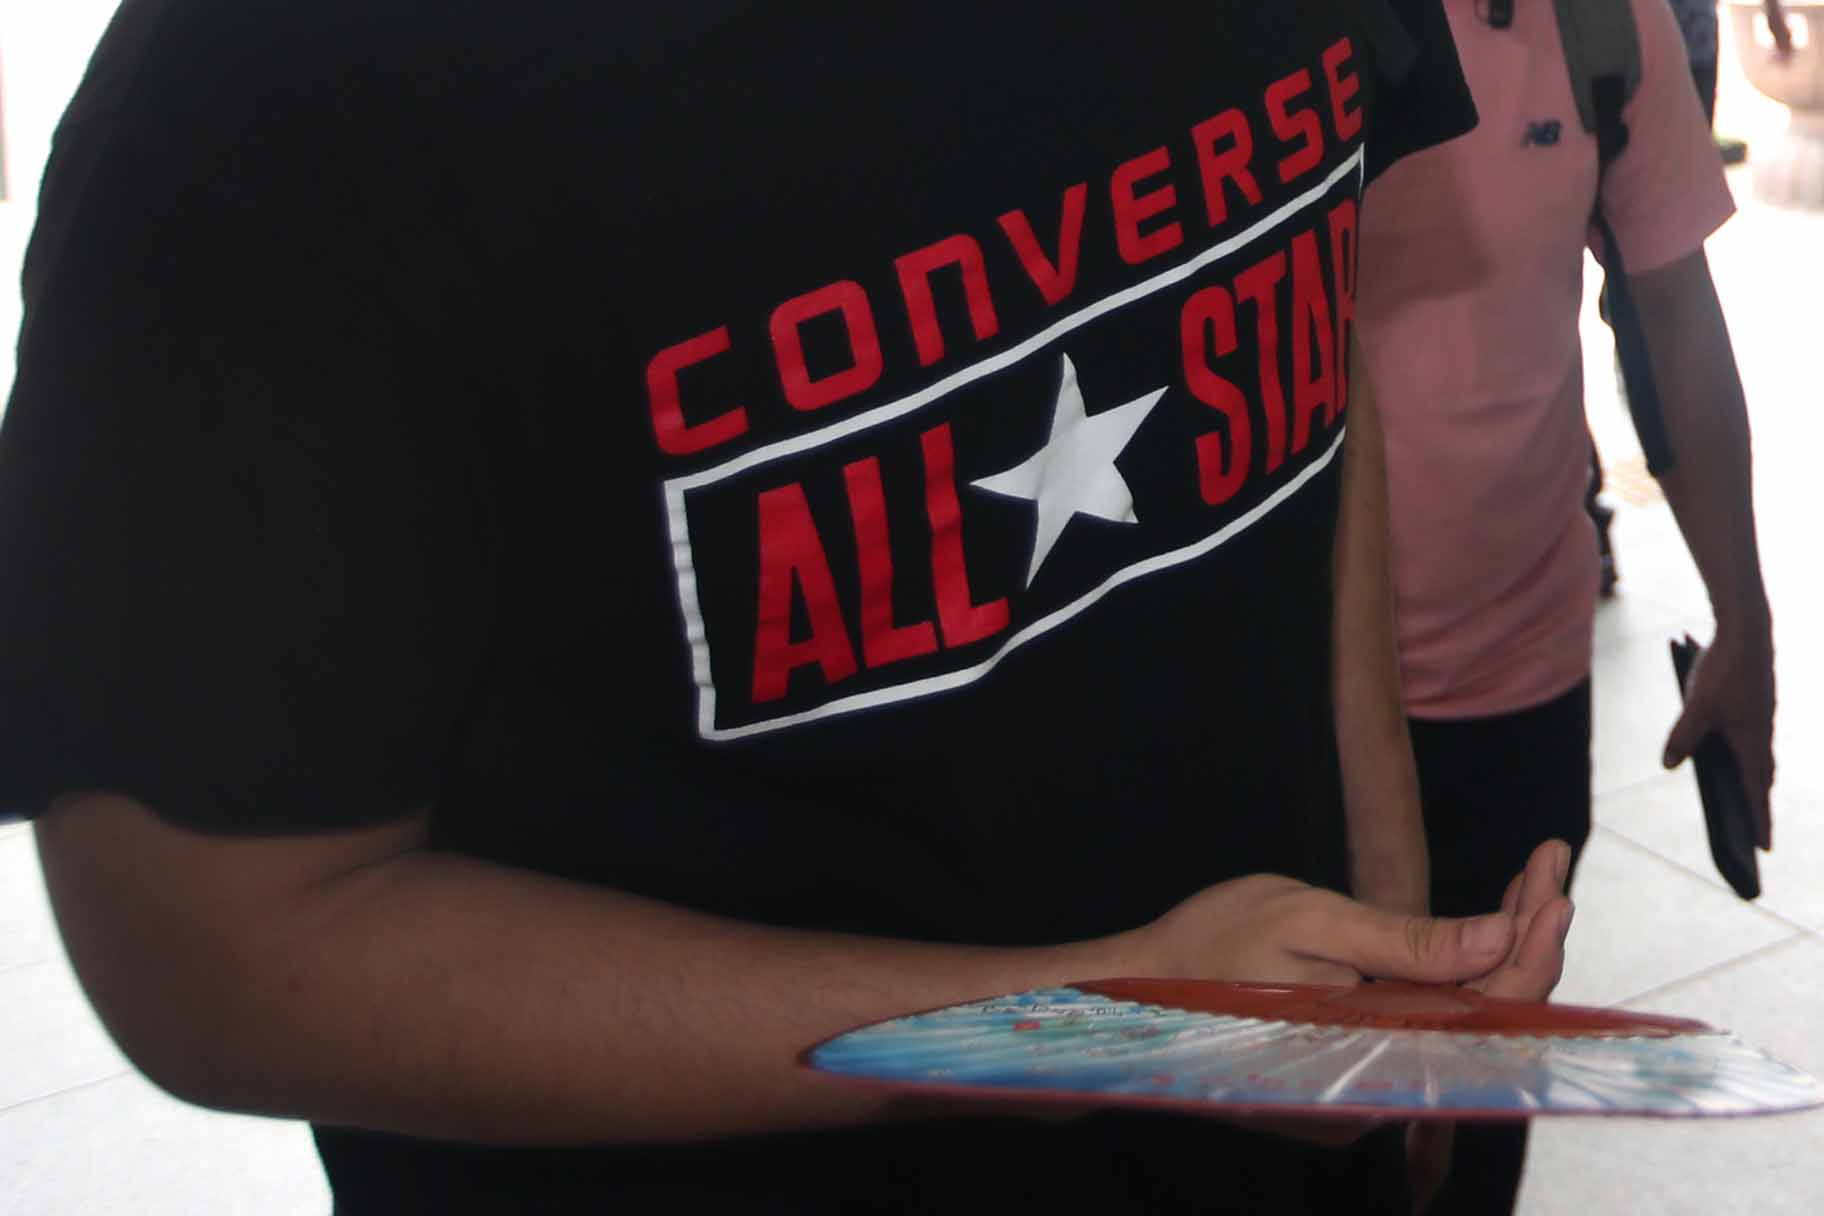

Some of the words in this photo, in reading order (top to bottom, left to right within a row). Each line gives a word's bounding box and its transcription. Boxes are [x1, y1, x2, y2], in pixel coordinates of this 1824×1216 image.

[645, 36, 1363, 456] CONVERSE
[751, 421, 1010, 706] ALL
[1179, 199, 1358, 506] STAR
